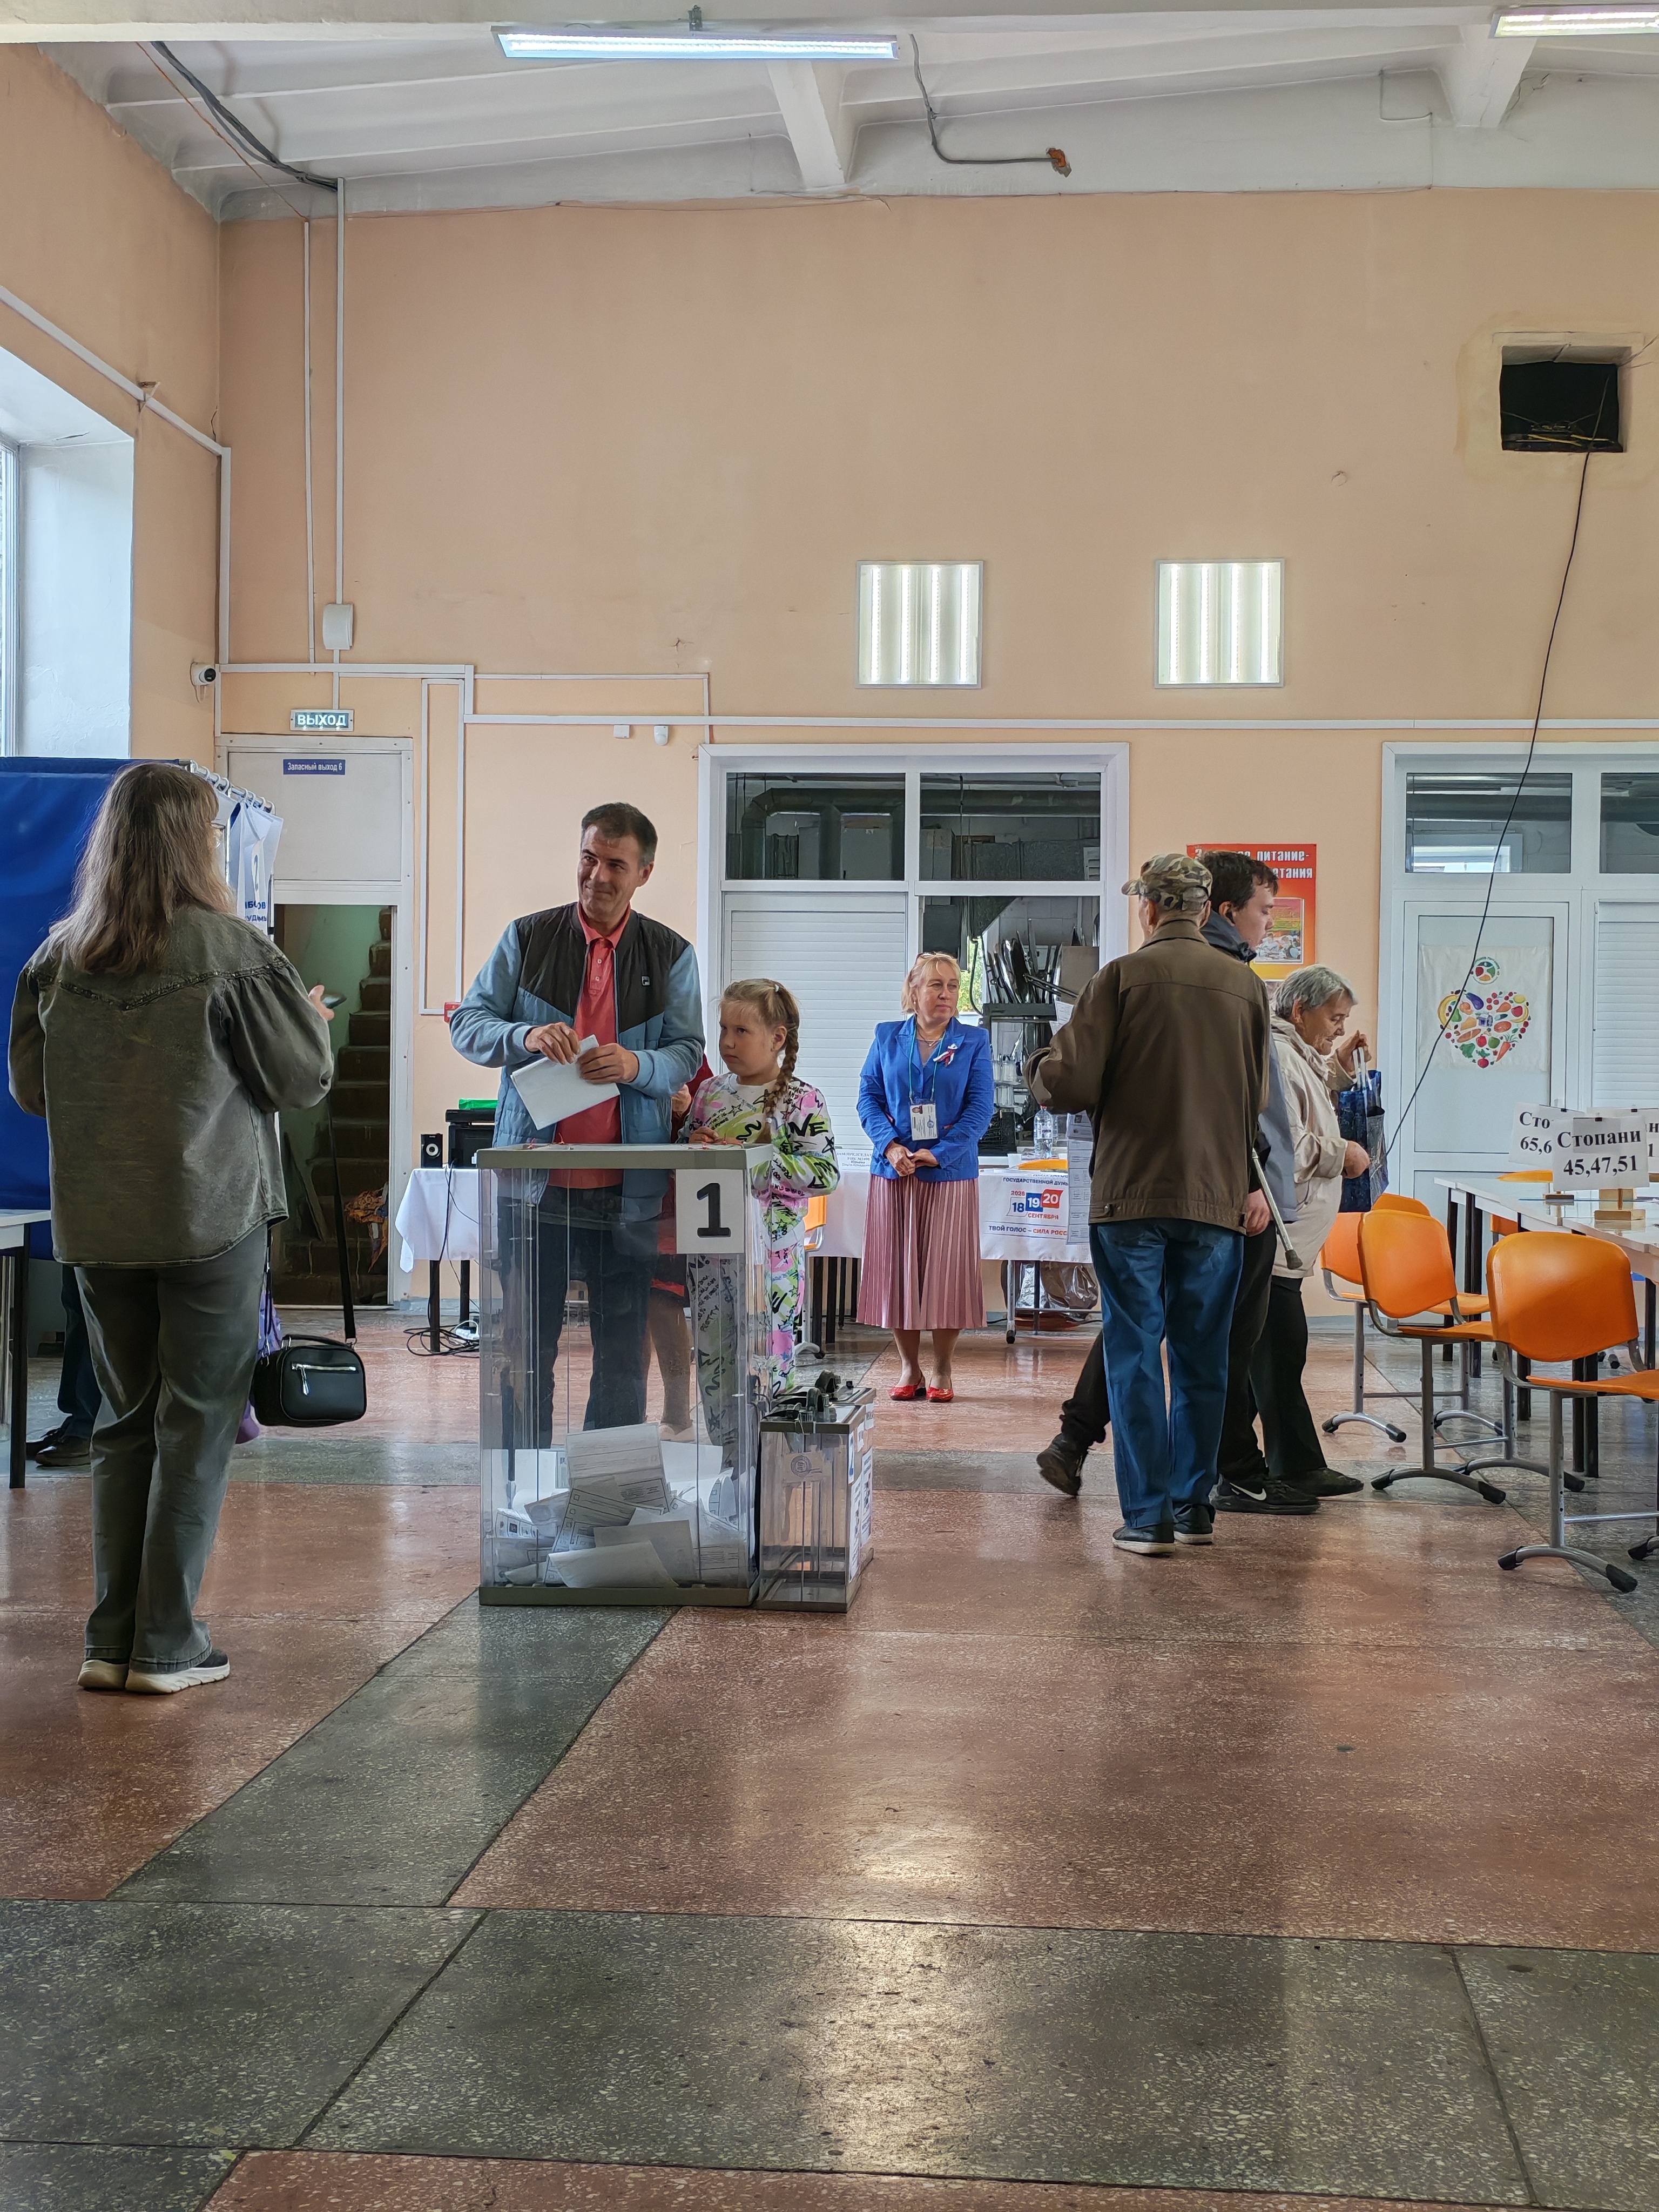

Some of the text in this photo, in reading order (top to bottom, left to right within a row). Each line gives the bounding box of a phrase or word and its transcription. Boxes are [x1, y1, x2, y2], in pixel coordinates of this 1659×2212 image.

[298, 714, 346, 726] ВЫХОД
[287, 762, 342, 772] Запасный выход 6
[1256, 851, 1310, 862] питание-
[1272, 867, 1313, 879] етания
[1557, 1130, 1641, 1148] Стопани
[1520, 1136, 1553, 1155] 65,6
[1563, 1155, 1638, 1178] 45,47,51
[1003, 1177, 1053, 1185] ГОСУДАРСТВЕННОЙ
[1027, 1197, 1040, 1208] 19
[1042, 1193, 1058, 1204] 20
[697, 1183, 731, 1238] 1
[1012, 1202, 1024, 1213] 18
